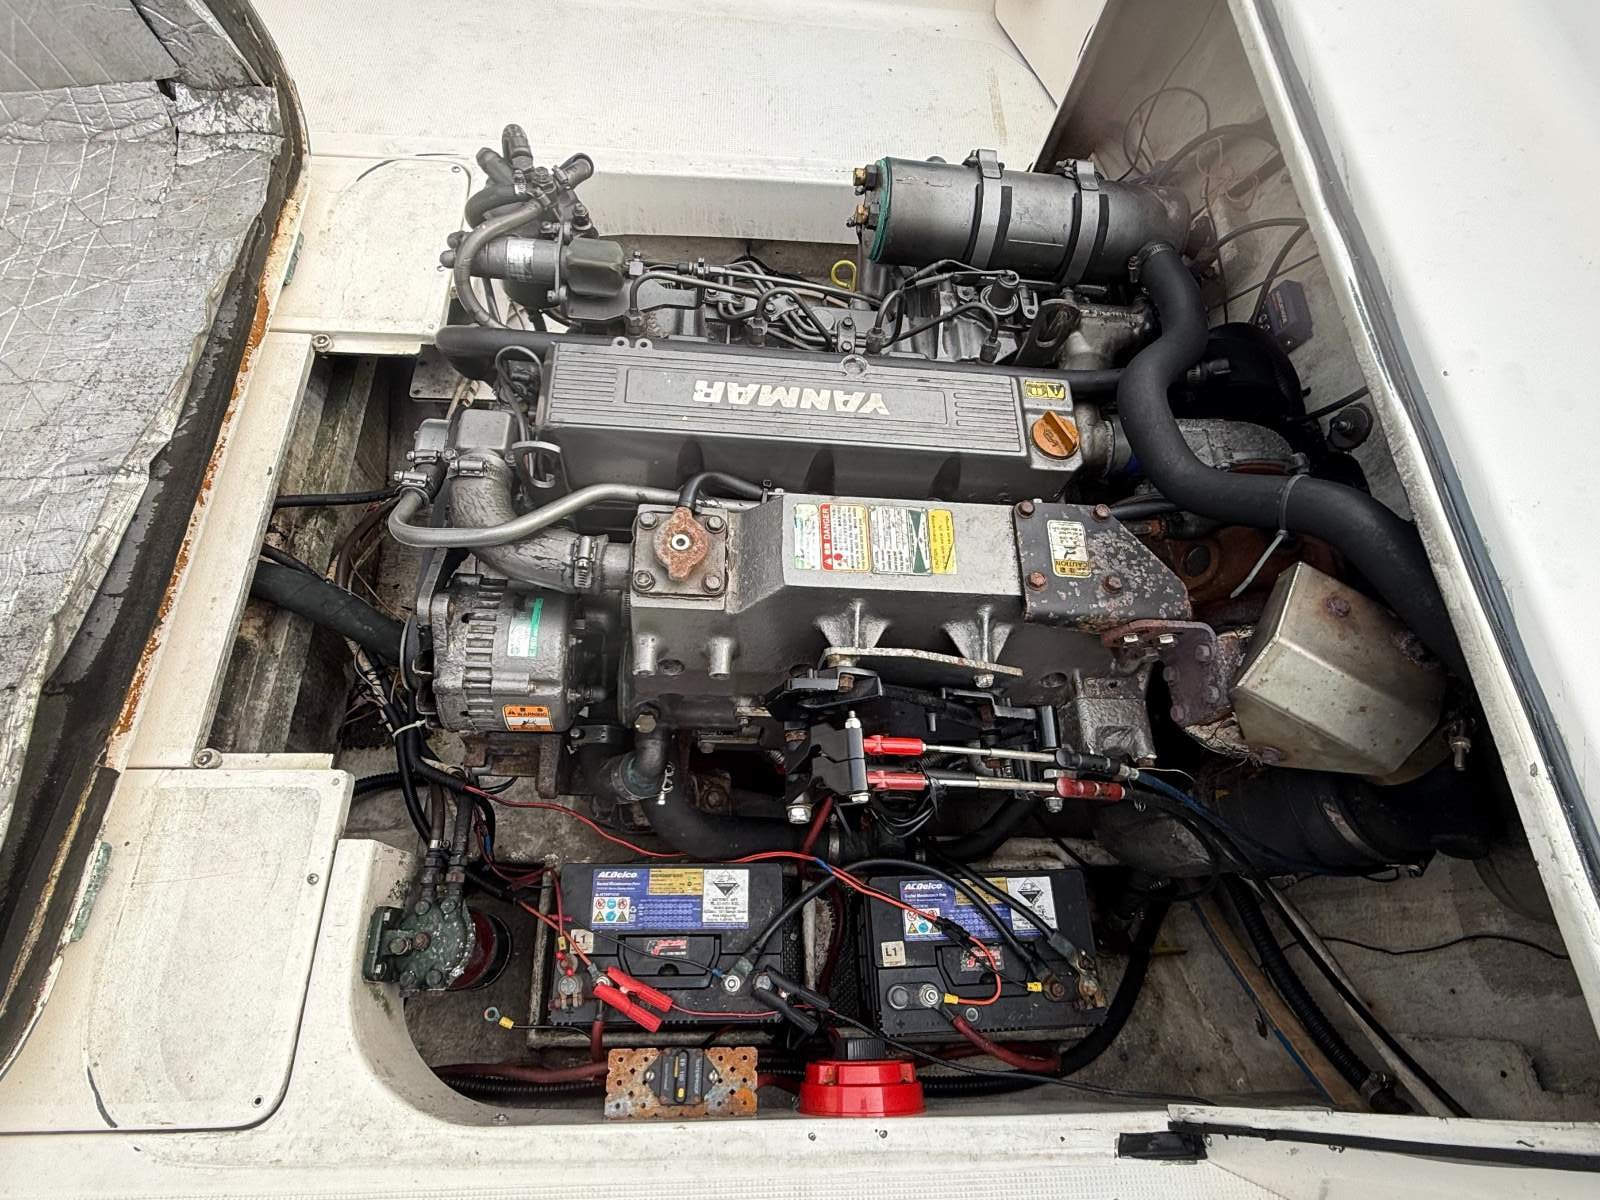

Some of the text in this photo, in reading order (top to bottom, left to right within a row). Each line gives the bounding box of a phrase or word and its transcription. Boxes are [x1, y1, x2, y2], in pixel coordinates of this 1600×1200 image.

[692, 380, 890, 416] YANMAR
[823, 508, 831, 541] DANGER
[1055, 560, 1089, 568] CAUTION
[598, 871, 638, 879] ACDelco
[573, 934, 587, 944] L1
[885, 947, 897, 957] L1
